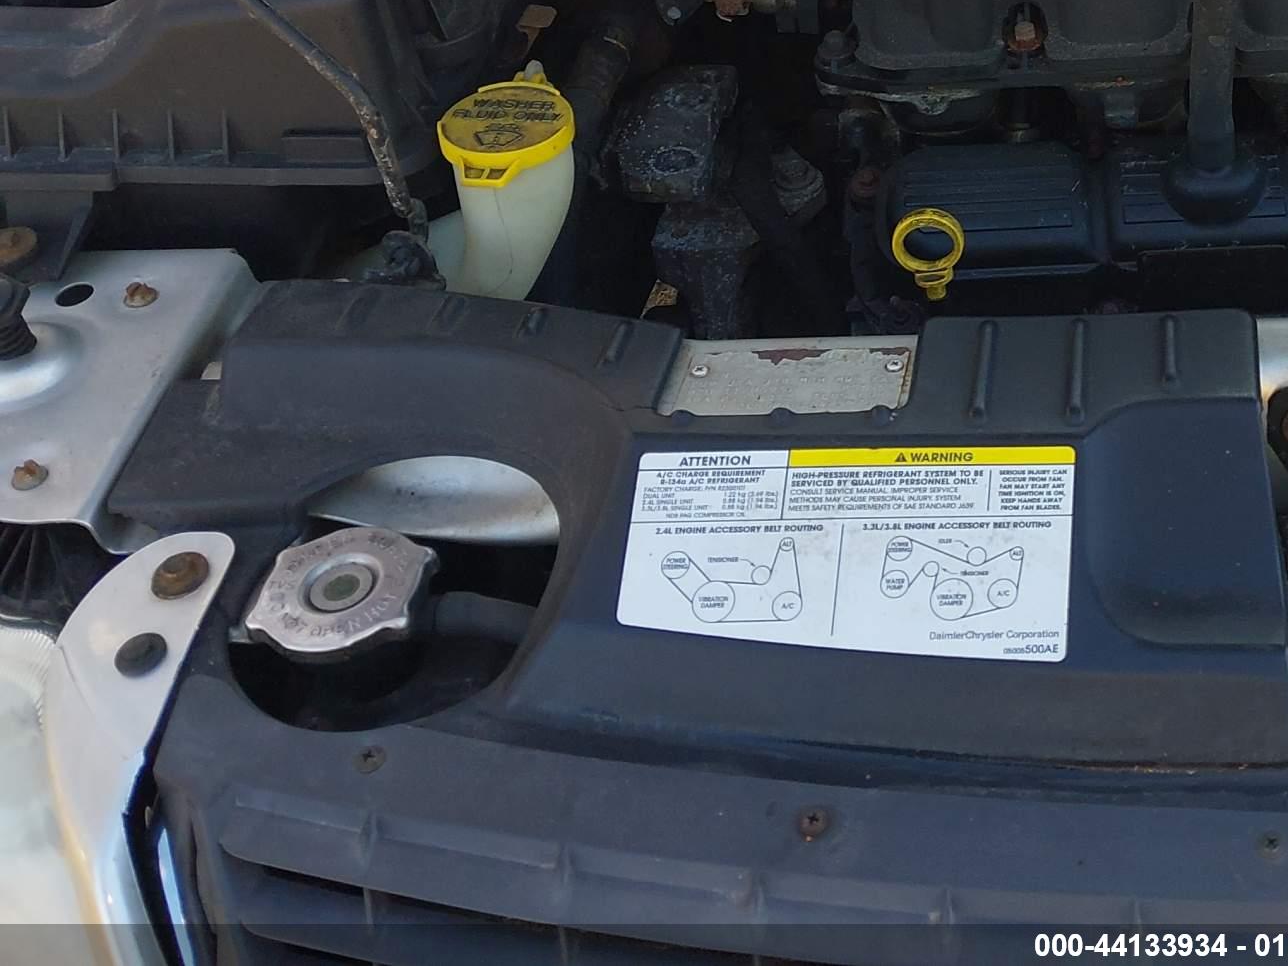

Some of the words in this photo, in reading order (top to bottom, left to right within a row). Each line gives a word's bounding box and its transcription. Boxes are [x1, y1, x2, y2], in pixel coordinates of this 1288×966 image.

[474, 99, 555, 110] WASHER
[453, 108, 507, 120] FLUID
[514, 110, 564, 123] ONLY
[680, 456, 751, 466] ATTENTION
[911, 452, 974, 462] WARNING
[710, 526, 761, 534] ACCESSORY
[929, 630, 1004, 642] DaimlerChrysler
[1006, 630, 1060, 640] Corporation
